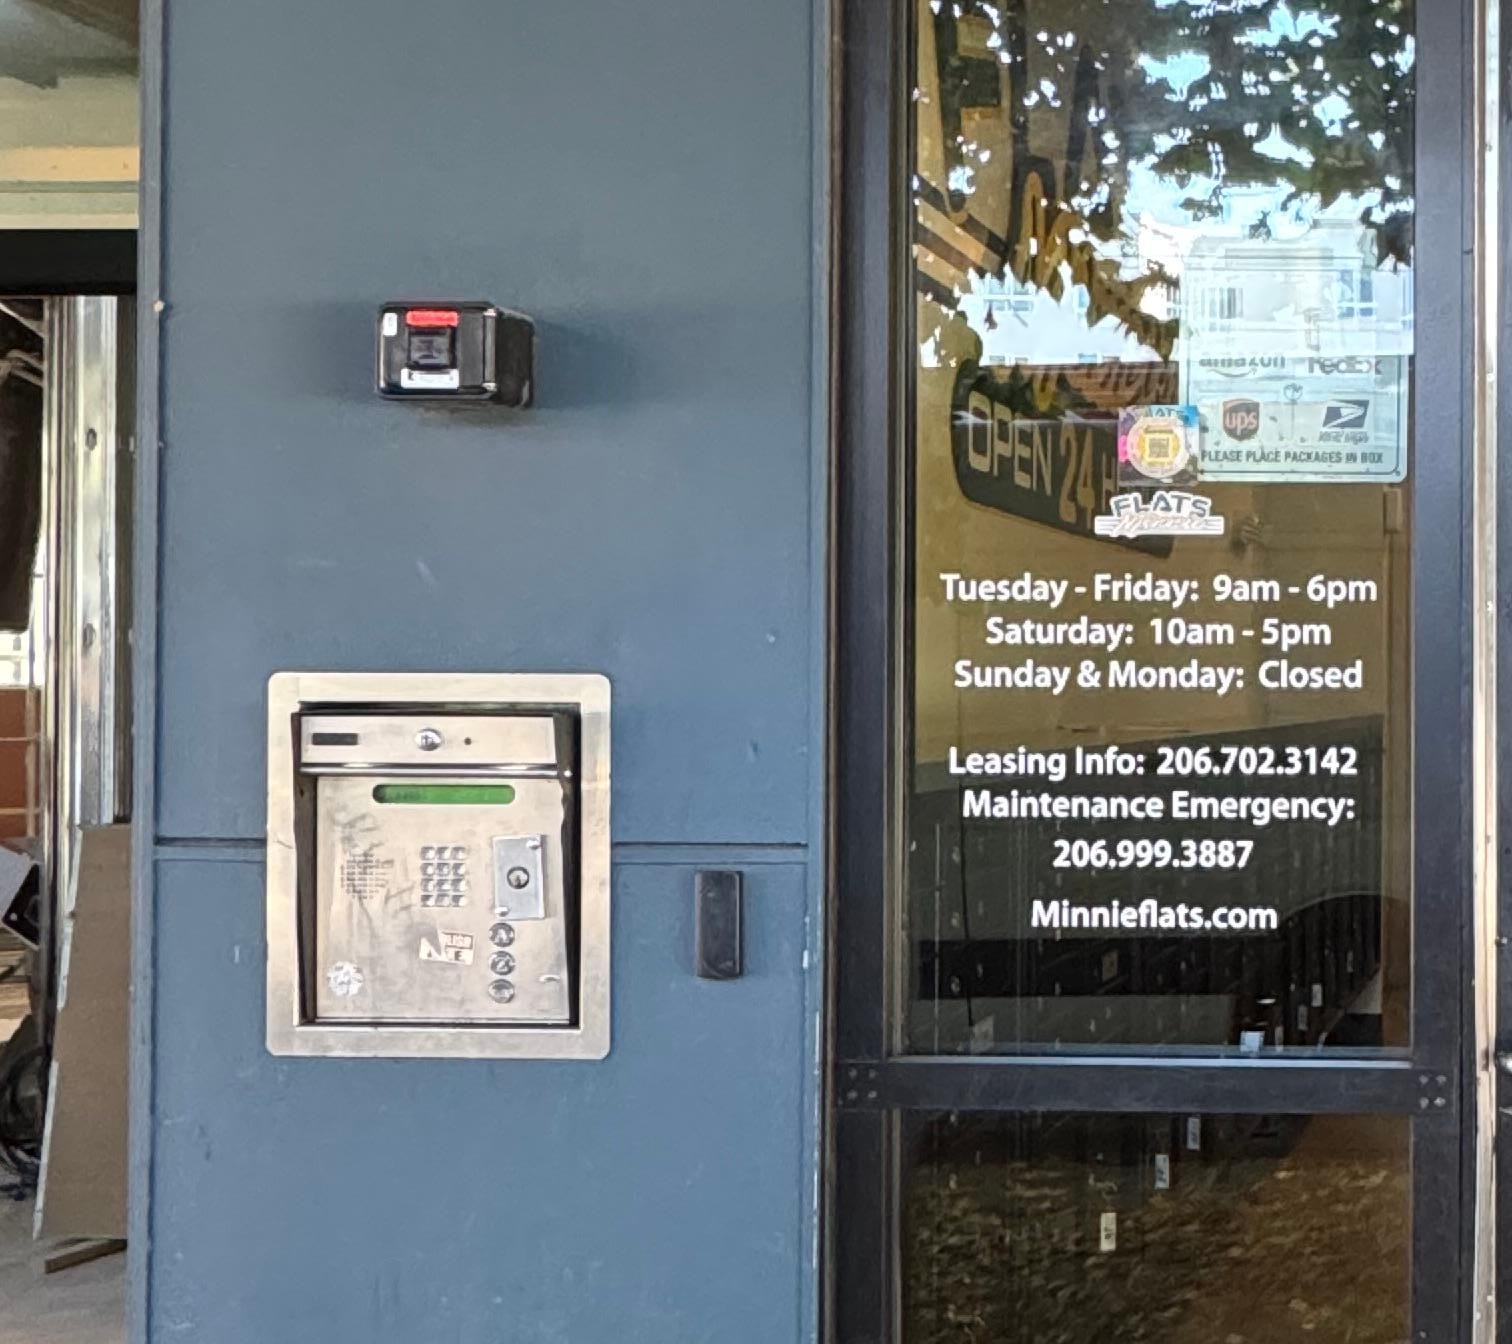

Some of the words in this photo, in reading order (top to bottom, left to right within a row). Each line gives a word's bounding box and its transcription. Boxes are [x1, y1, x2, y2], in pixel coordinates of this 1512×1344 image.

[1224, 410, 1258, 436] ups
[968, 390, 1052, 497] OPEN
[1057, 418, 1096, 531] 24
[1200, 449, 1243, 464] PLEASE
[1245, 449, 1282, 464] PLACE
[1284, 450, 1343, 464] PACKAGES
[1360, 452, 1384, 465] BOX
[1112, 491, 1211, 518] FLATS
[939, 572, 1069, 609] Tuesday
[1094, 572, 1200, 609] Friday:
[1212, 574, 1280, 602] 9am
[1306, 574, 1378, 609] 6pm
[985, 615, 1134, 652] Saturday:
[1150, 617, 1234, 646] 10am
[1261, 618, 1332, 652] 5pm
[954, 658, 1071, 696] Sunday
[1076, 659, 1101, 689] &
[1108, 658, 1244, 696] Monday:
[1258, 658, 1363, 689] Closed
[949, 745, 1066, 782] Leasing
[1075, 745, 1145, 776] Info:
[1156, 745, 1358, 776] 206.702.3142
[962, 789, 1164, 819] Maintenance
[1172, 790, 1355, 826] Emergency:
[1052, 839, 1254, 869] 206.999.3887
[1031, 898, 1278, 930] Minnieflats.com
